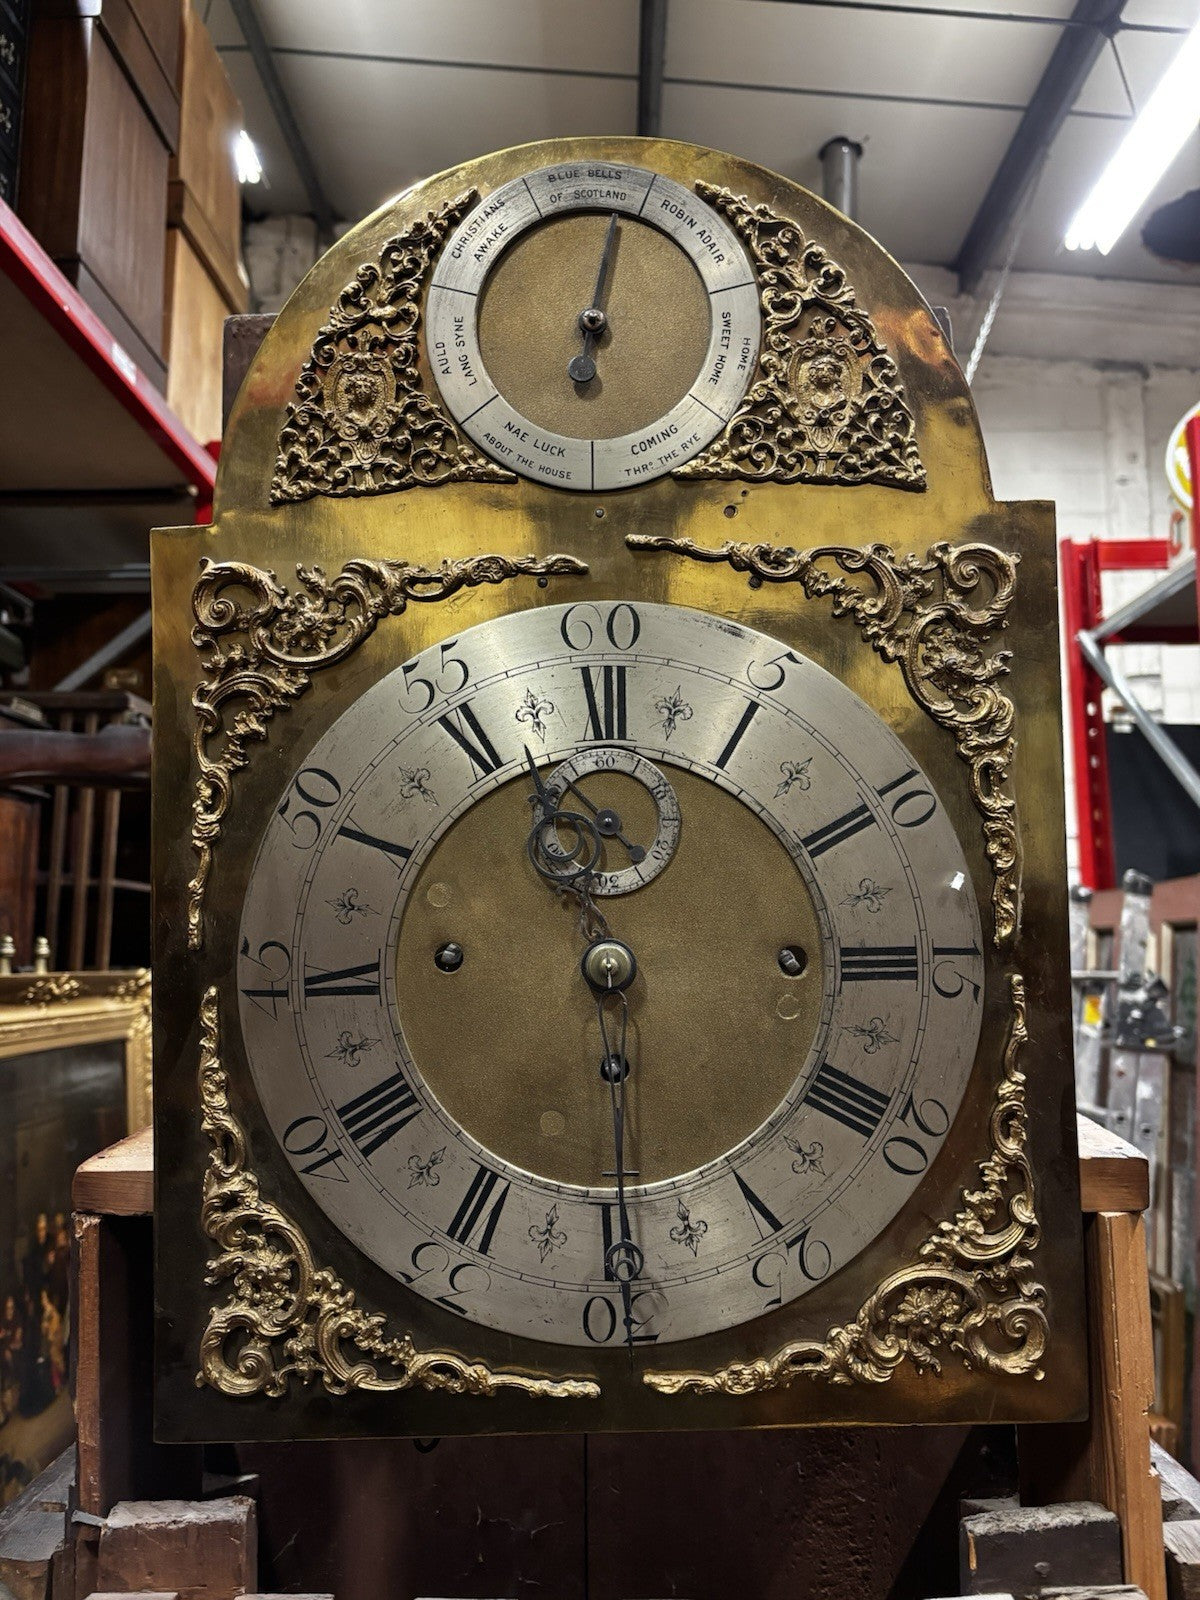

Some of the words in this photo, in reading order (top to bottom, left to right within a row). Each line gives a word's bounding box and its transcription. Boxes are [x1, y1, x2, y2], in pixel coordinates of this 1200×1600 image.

[548, 169, 580, 183] BLUE
[588, 169, 622, 179] BELLS
[550, 192, 563, 204] OF
[574, 189, 627, 201] SCOTLAND
[451, 198, 505, 259] CHRISTIANS
[474, 223, 509, 263] AWAKE
[660, 199, 697, 229] ROBIN
[435, 341, 452, 375] AULD
[454, 316, 465, 347] SYNE
[721, 311, 731, 350] SWEET
[737, 337, 751, 371] HOME
[458, 354, 478, 387] LANG
[709, 354, 727, 385] HOME
[483, 432, 513, 456] ABOUT
[516, 454, 534, 468] THE
[538, 465, 572, 480] HOUSE
[504, 421, 529, 442] NAE
[533, 439, 566, 457] LUCK
[631, 424, 678, 455] COMING
[657, 449, 679, 466] THE
[680, 433, 701, 451] RYE
[560, 603, 640, 650] 60
[398, 639, 469, 714] 55
[746, 651, 803, 691] 5
[572, 665, 637, 743] XII
[428, 697, 517, 789] XI
[594, 756, 615, 768] 60
[707, 695, 767, 775] I
[277, 768, 342, 850] 50
[872, 764, 937, 828] 10
[331, 803, 420, 879] X
[792, 792, 881, 871] II
[240, 936, 291, 1021] 45
[303, 948, 382, 1011] IX
[837, 935, 918, 996] III
[931, 938, 982, 1004] 15
[330, 1062, 424, 1166] VIII
[797, 1052, 897, 1148] IIII
[283, 1115, 350, 1183] 40
[882, 1090, 949, 1175] 20
[434, 1157, 512, 1259] VII
[732, 1166, 795, 1247] V
[397, 1241, 491, 1315] 35
[752, 1226, 831, 1309] 25
[583, 1290, 669, 1343] 30
